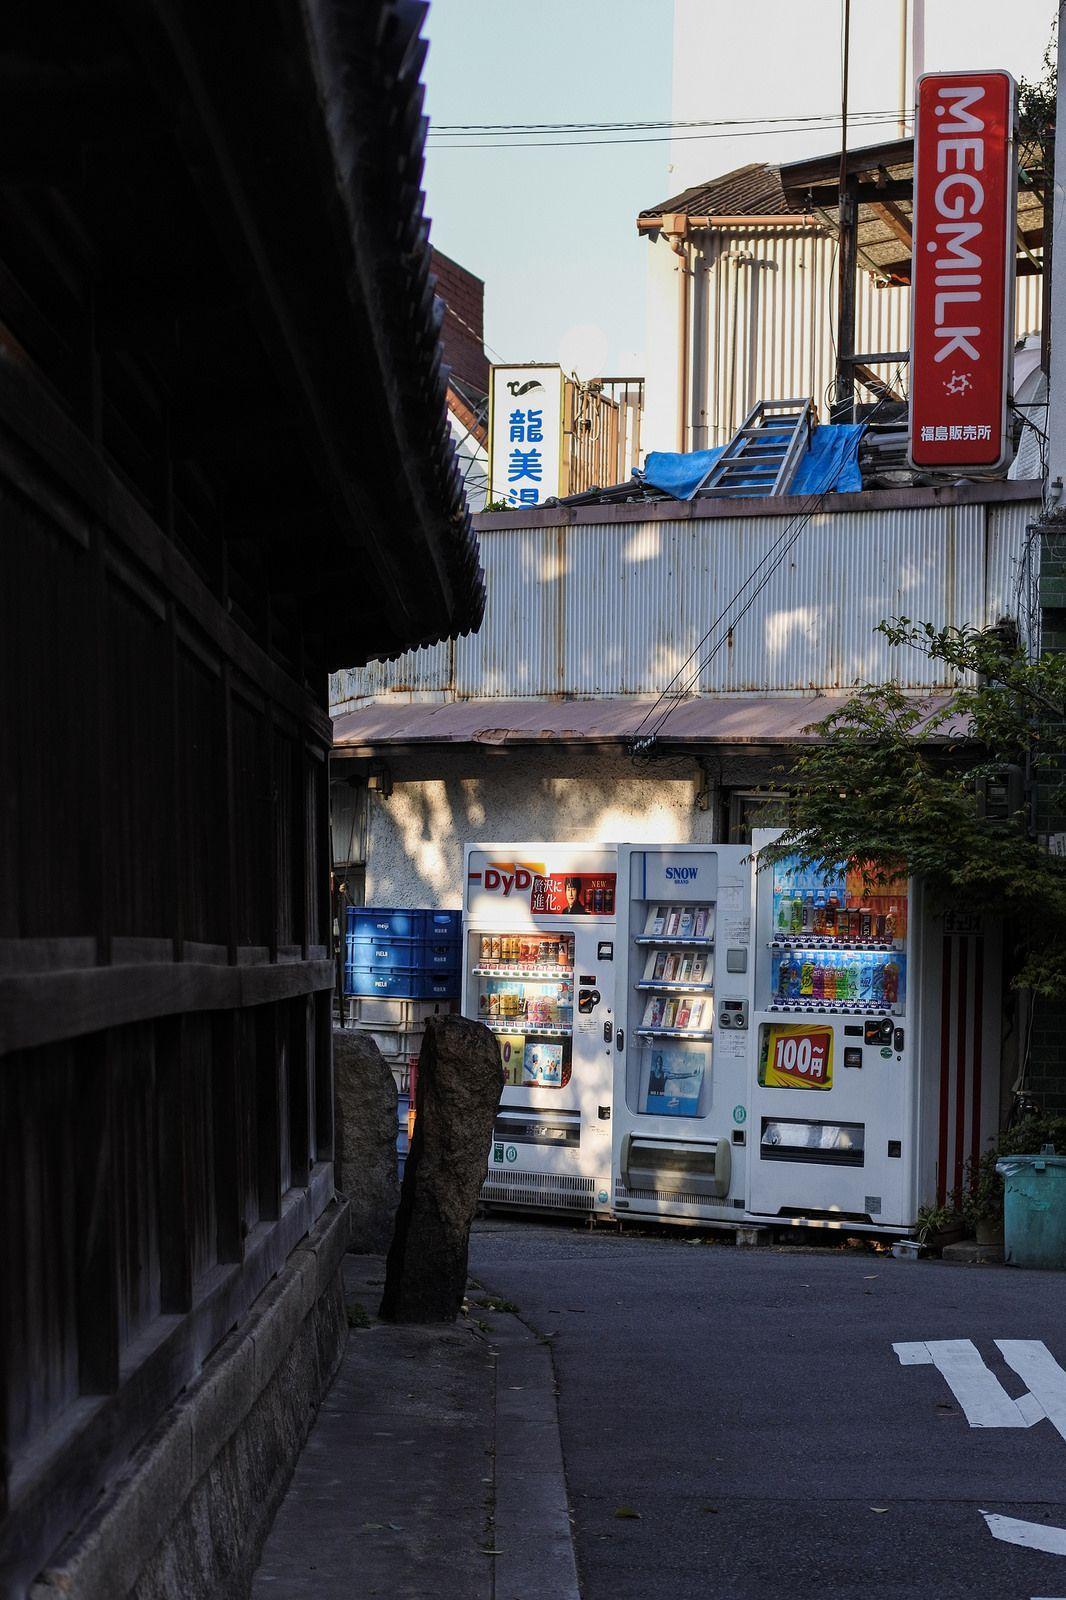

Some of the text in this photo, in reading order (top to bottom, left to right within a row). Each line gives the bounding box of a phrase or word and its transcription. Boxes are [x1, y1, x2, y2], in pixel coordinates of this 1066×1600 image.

[926, 85, 986, 363] MEGMILK
[920, 425, 992, 442] 福島販売所
[665, 867, 699, 880] SNOW
[485, 869, 549, 896] DyD
[591, 880, 607, 888] NEW
